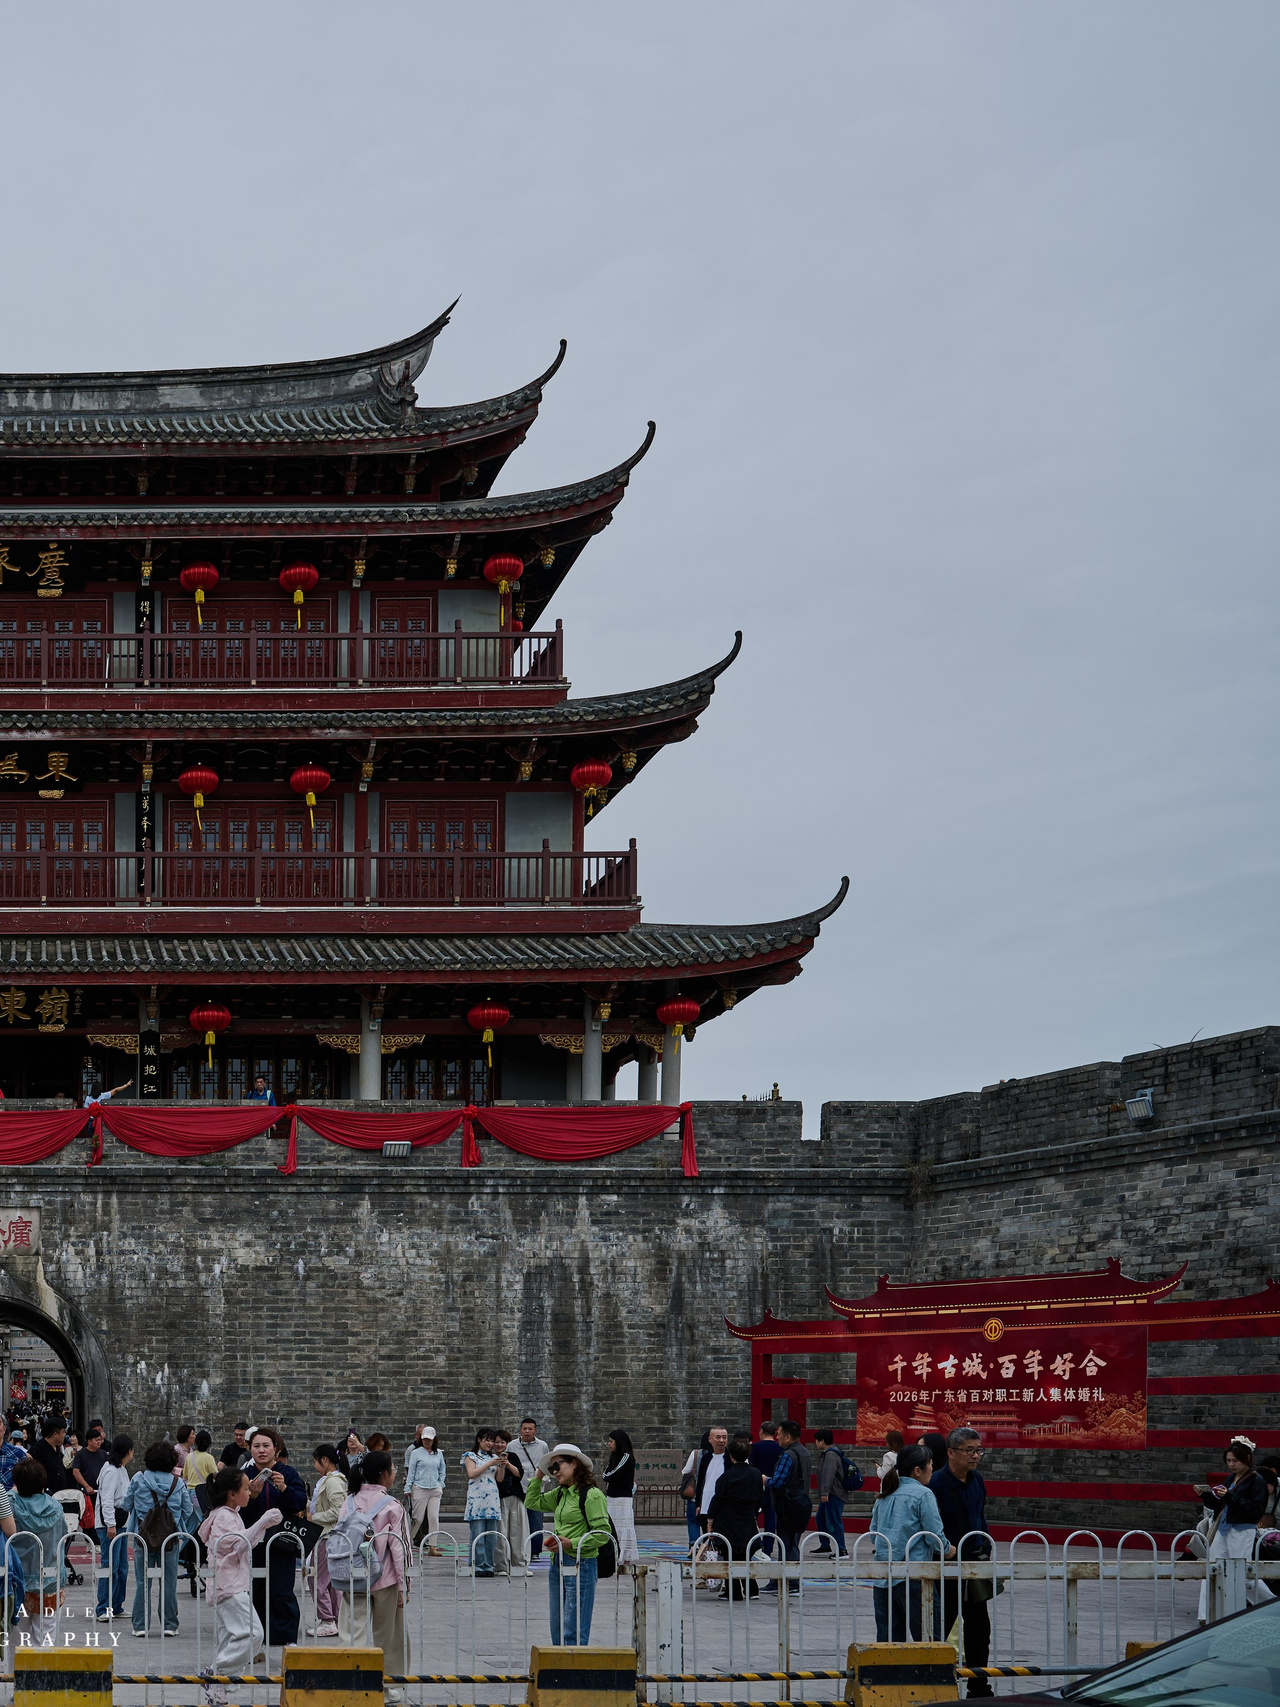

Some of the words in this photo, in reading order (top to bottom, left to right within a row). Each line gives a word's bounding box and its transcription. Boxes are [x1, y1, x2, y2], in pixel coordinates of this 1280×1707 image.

[889, 1387, 1105, 1403] 2026年广东省百对职工新人集体婚礼
